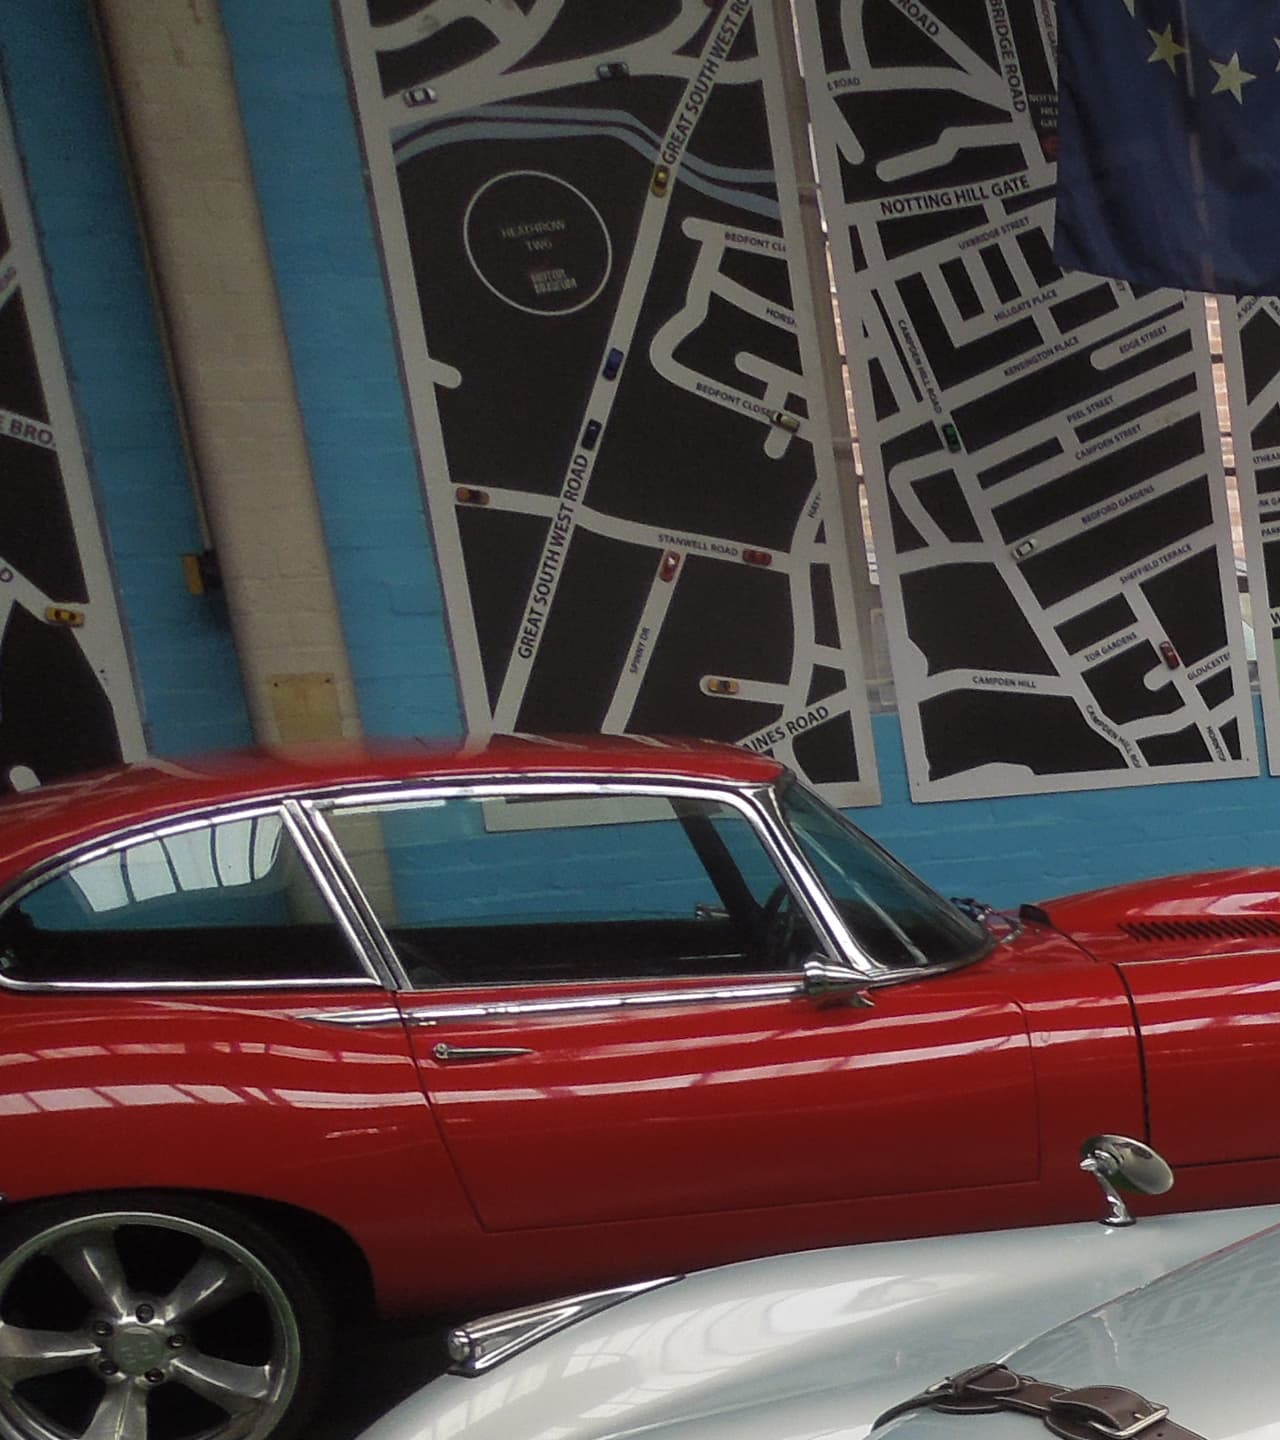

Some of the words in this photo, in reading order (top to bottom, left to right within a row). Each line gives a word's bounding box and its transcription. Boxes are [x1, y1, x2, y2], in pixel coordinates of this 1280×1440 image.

[662, 112, 692, 165] GREAT
[686, 61, 719, 113] SOUTH
[709, 18, 738, 61] WEST
[834, 77, 859, 88] ROAD
[1006, 64, 1026, 112] ROAD
[879, 190, 951, 216] NOTTING
[954, 184, 990, 204] HILL
[991, 175, 1031, 198] GATE
[724, 230, 768, 249] BEDFONT
[1032, 289, 1056, 304] PLACE
[897, 319, 922, 365] CAMPDEN
[917, 366, 930, 385] HILL
[926, 387, 942, 414] ROAD
[1003, 349, 1054, 376] KENSINGTON
[1054, 336, 1078, 352] PLACE
[695, 383, 740, 404] BEDFONT
[1074, 437, 1114, 459] CAMPDEN
[1113, 424, 1141, 440] STREET
[1118, 485, 1154, 505] GARDENS
[657, 533, 708, 553] STANWELL
[711, 542, 739, 557] ROAD
[1260, 526, 1280, 536] PARK
[518, 608, 546, 659] GREAT
[532, 553, 561, 607] SOUTH
[550, 503, 575, 552] WEST
[563, 454, 589, 502] ROAD
[1085, 650, 1100, 661] TOR
[1100, 632, 1136, 653] GARDENS
[972, 676, 1015, 686] CAMPDEN
[743, 725, 786, 752] AINES
[785, 706, 829, 737] ROAD
[1084, 704, 1117, 741] CAMPDEN
[1116, 736, 1132, 754] HILL
